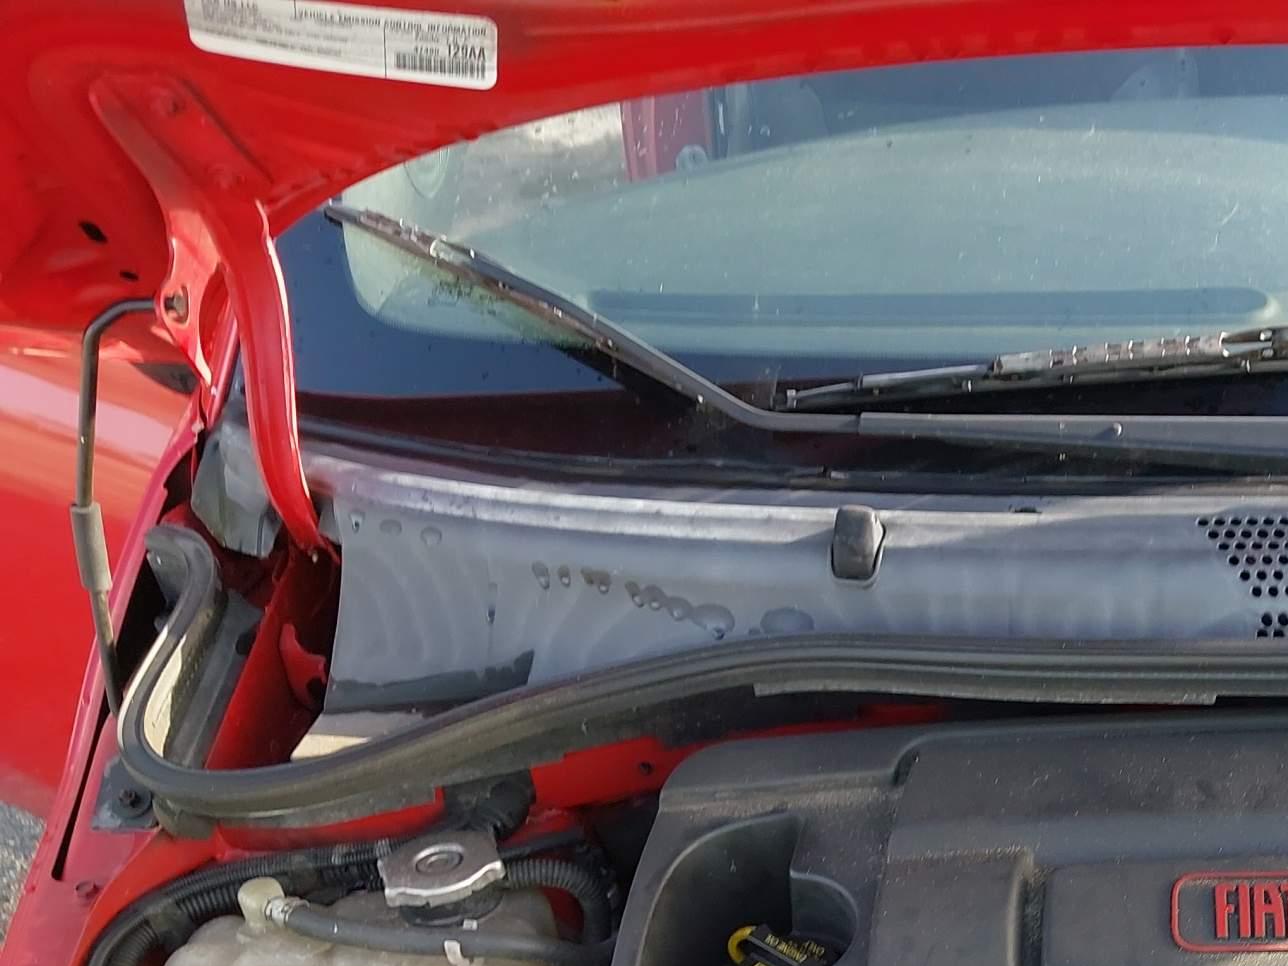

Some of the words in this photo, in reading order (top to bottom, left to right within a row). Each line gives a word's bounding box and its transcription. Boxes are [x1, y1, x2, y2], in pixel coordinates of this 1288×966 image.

[337, 13, 381, 26] EMISSION
[427, 23, 487, 36] INFORMATION
[447, 44, 486, 60] 129AA
